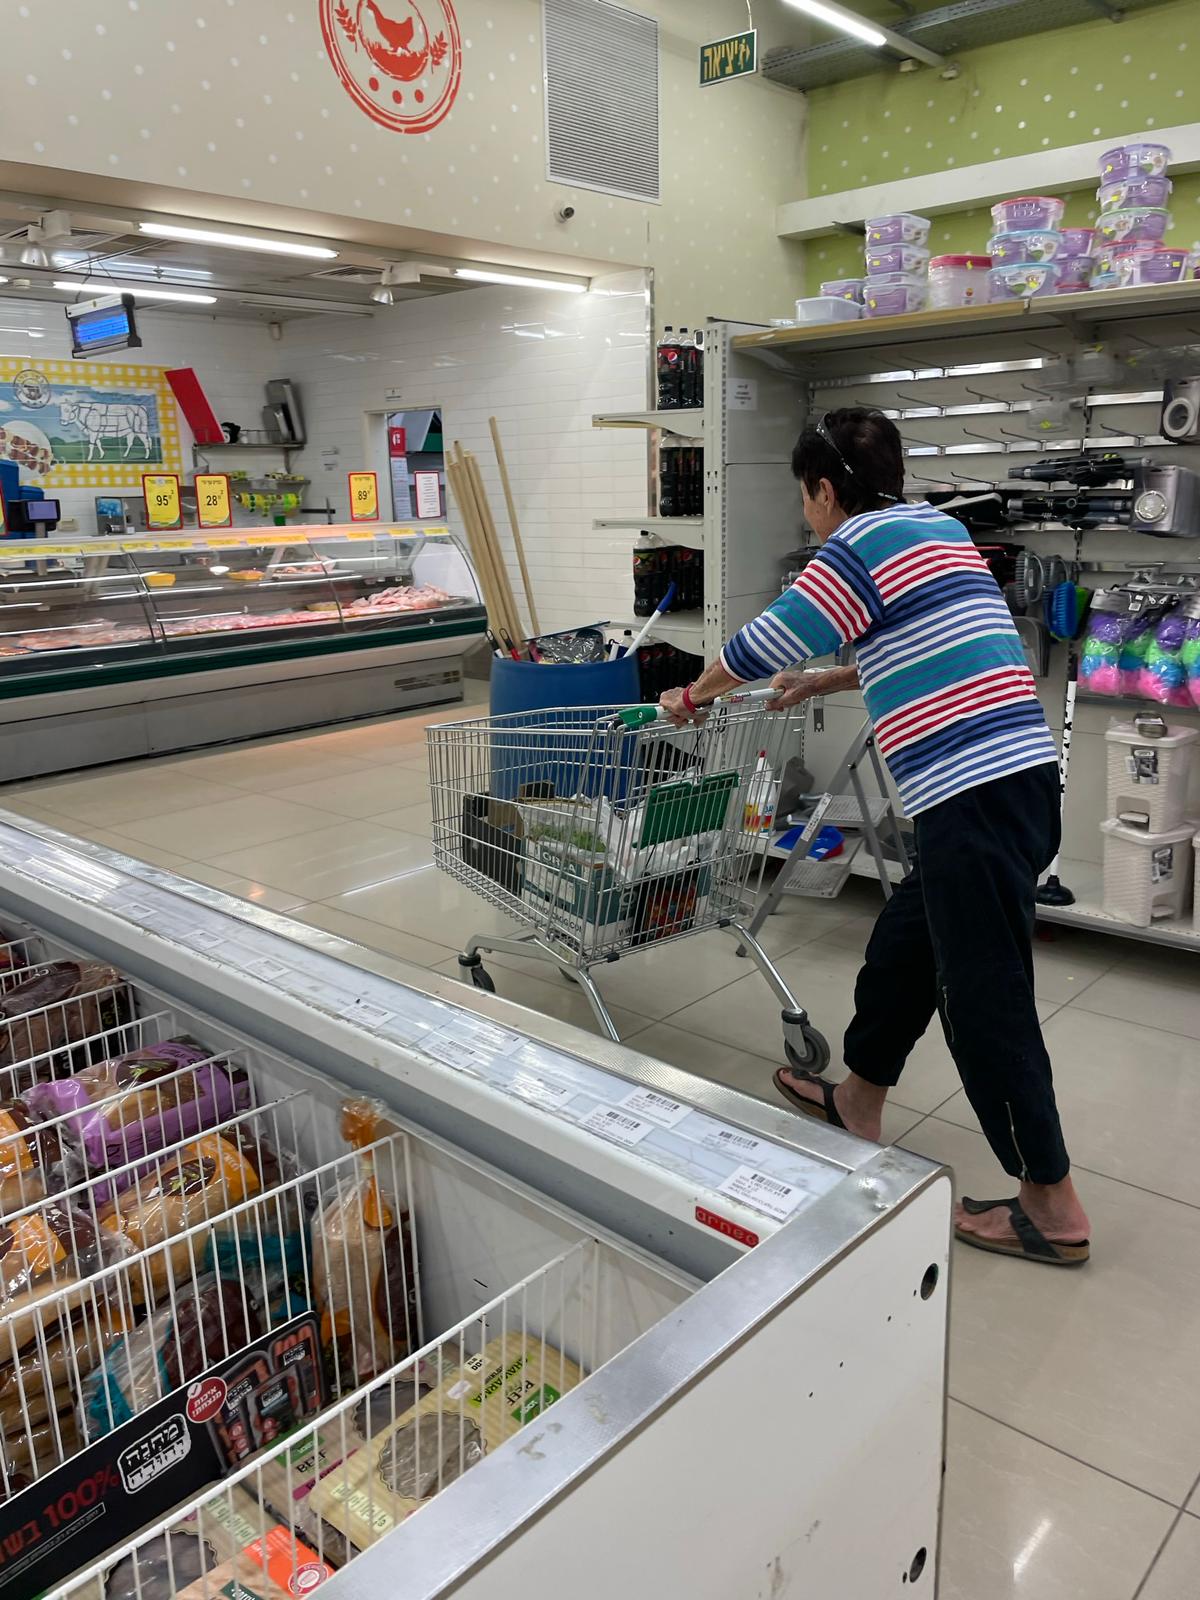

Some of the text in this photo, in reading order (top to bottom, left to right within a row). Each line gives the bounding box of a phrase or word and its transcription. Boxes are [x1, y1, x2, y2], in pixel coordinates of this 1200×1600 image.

[703, 40, 738, 80] יציאה
[156, 495, 169, 506] 95
[206, 495, 218, 506] 28
[357, 490, 368, 500] 89
[542, 853, 576, 874] ORA
[473, 1356, 529, 1403] HAWARMA
[194, 1385, 218, 1408] איכות
[43, 1463, 120, 1528] 100%
